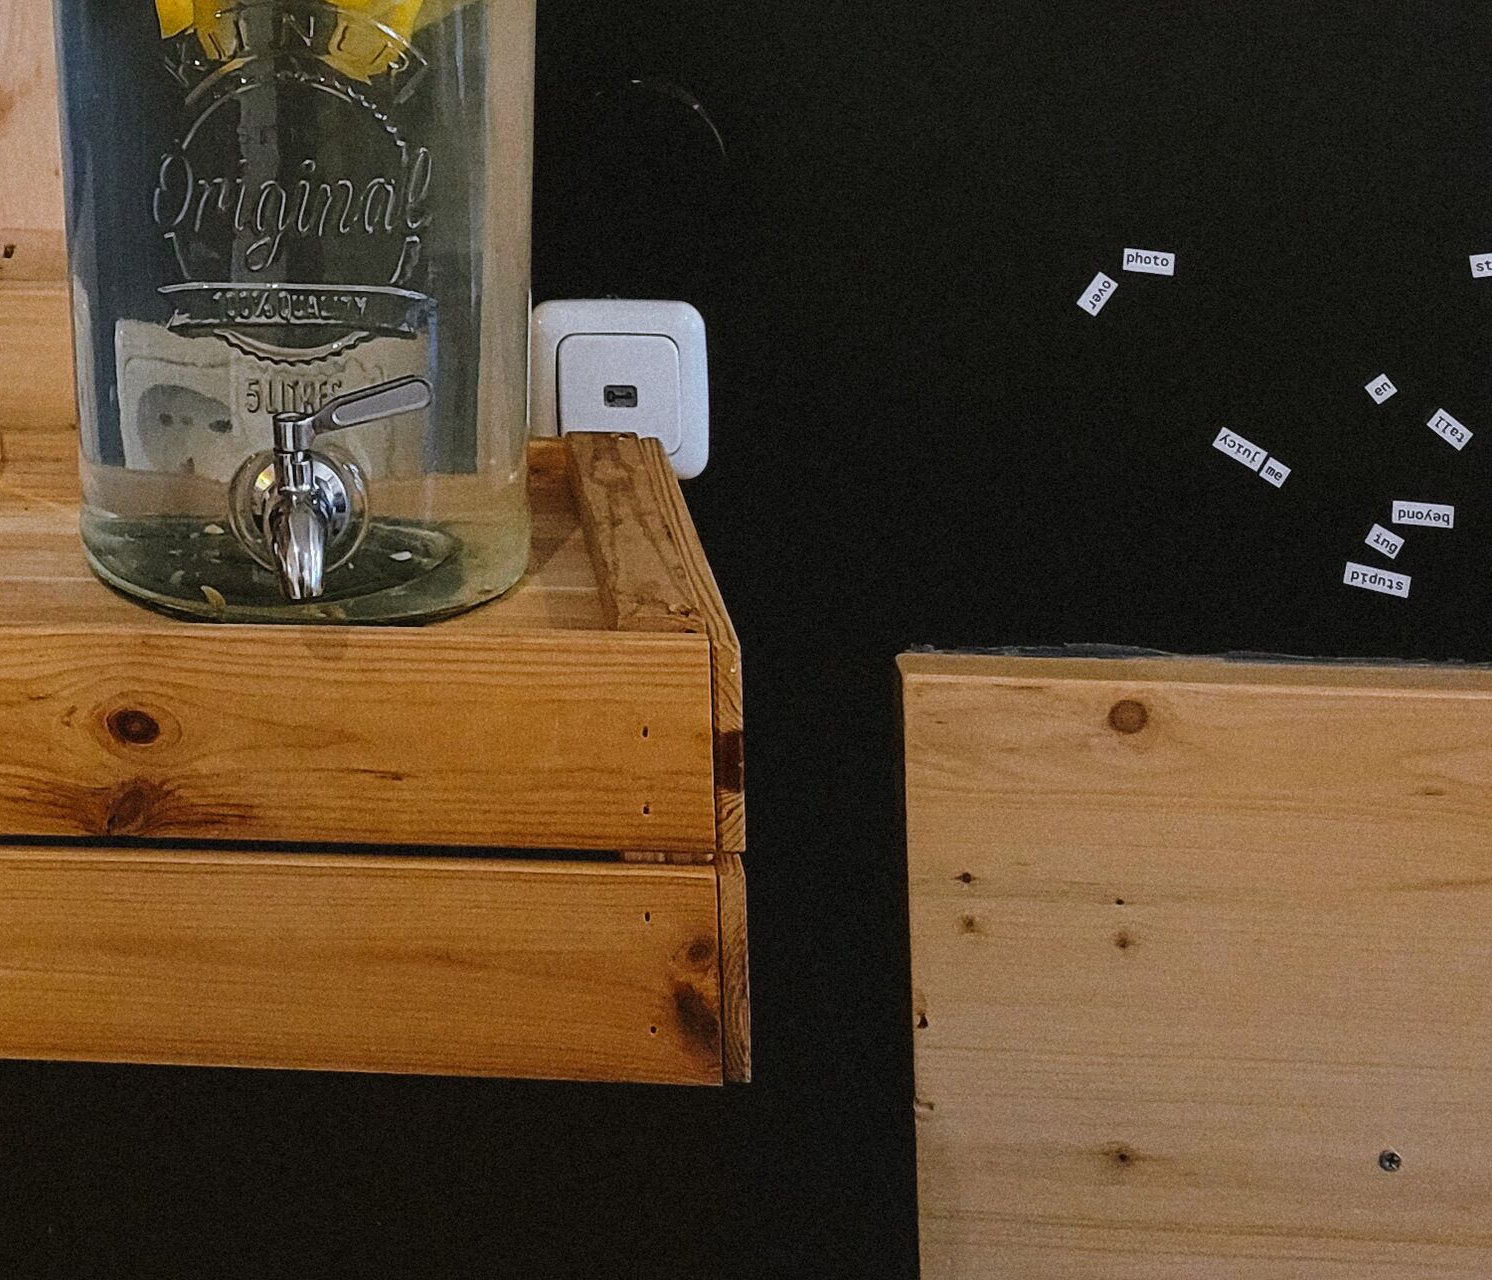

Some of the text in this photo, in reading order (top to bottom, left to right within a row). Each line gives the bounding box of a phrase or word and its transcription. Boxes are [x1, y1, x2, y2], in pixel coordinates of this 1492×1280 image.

[154, 146, 432, 272] Original
[1127, 252, 1169, 266] photo
[278, 290, 368, 324] QUALITY
[1088, 279, 1112, 310] over
[246, 378, 261, 414] 5
[1434, 415, 1465, 443] tall
[1218, 432, 1284, 482] juicy me
[1397, 508, 1452, 526] beyond
[1374, 533, 1398, 554] ing
[1350, 570, 1404, 591] stupid
